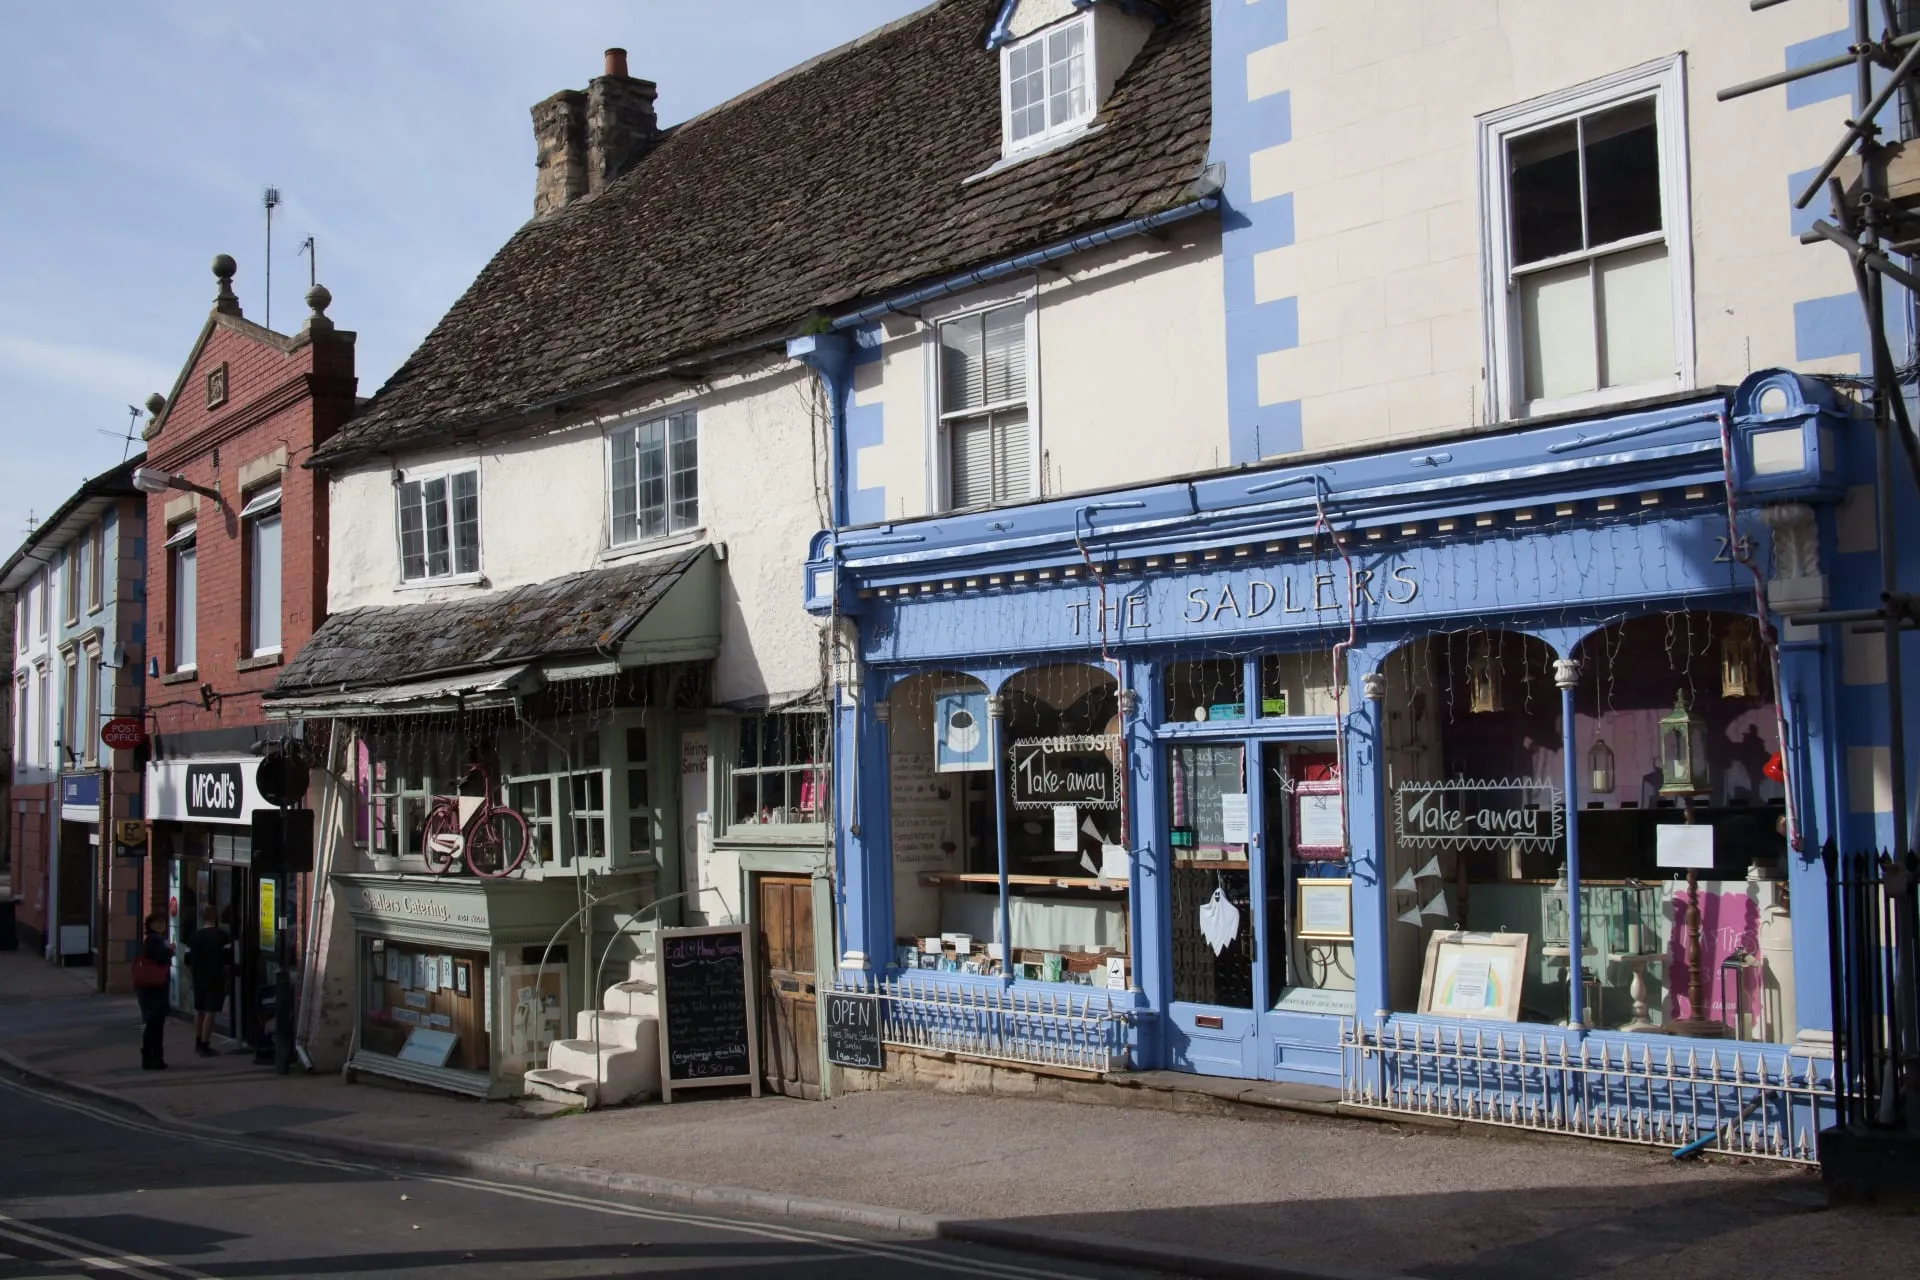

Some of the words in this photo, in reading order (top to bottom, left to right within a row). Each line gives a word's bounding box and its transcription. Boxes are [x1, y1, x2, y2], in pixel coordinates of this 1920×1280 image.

[1066, 593, 1151, 635] THE
[1184, 565, 1418, 623] SADLERS
[105, 733, 141, 742] OFFICE
[111, 724, 137, 733] POST
[684, 739, 708, 760] Hiring
[1018, 748, 1106, 803] Take-away
[192, 772, 235, 809] McColl's
[1407, 790, 1537, 836] Take-away
[362, 888, 401, 912] Sadlers
[832, 999, 870, 1027] OPEN
